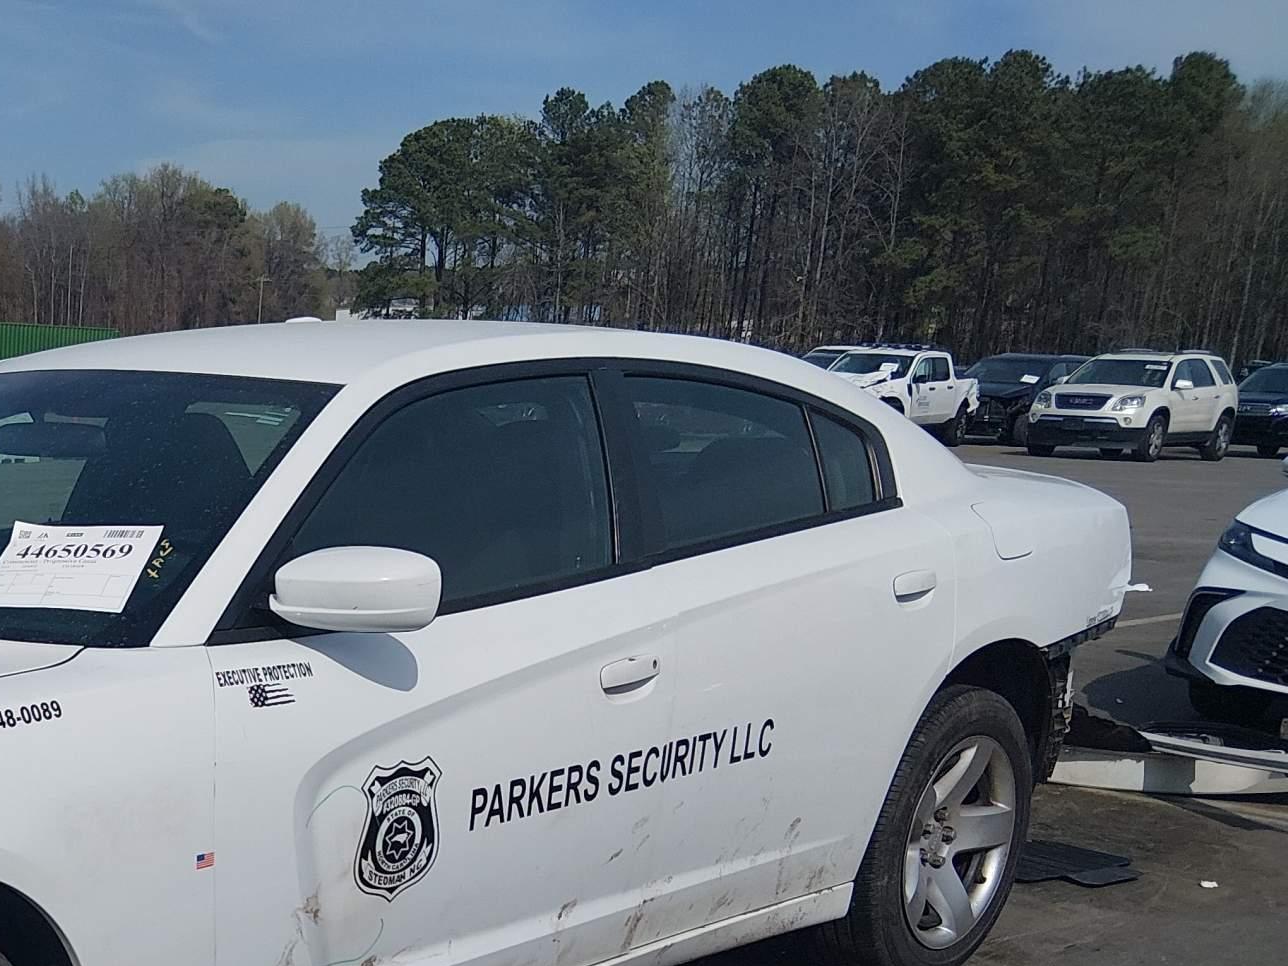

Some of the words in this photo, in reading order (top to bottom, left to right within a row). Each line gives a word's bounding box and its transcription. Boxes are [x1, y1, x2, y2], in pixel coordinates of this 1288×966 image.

[16, 543, 133, 560] 44650569
[215, 667, 262, 687] EXECUTIVE
[262, 662, 314, 681] PROTECTION
[469, 760, 600, 831] PARKERS
[607, 728, 727, 797] SECURITY
[729, 719, 775, 764] LLC
